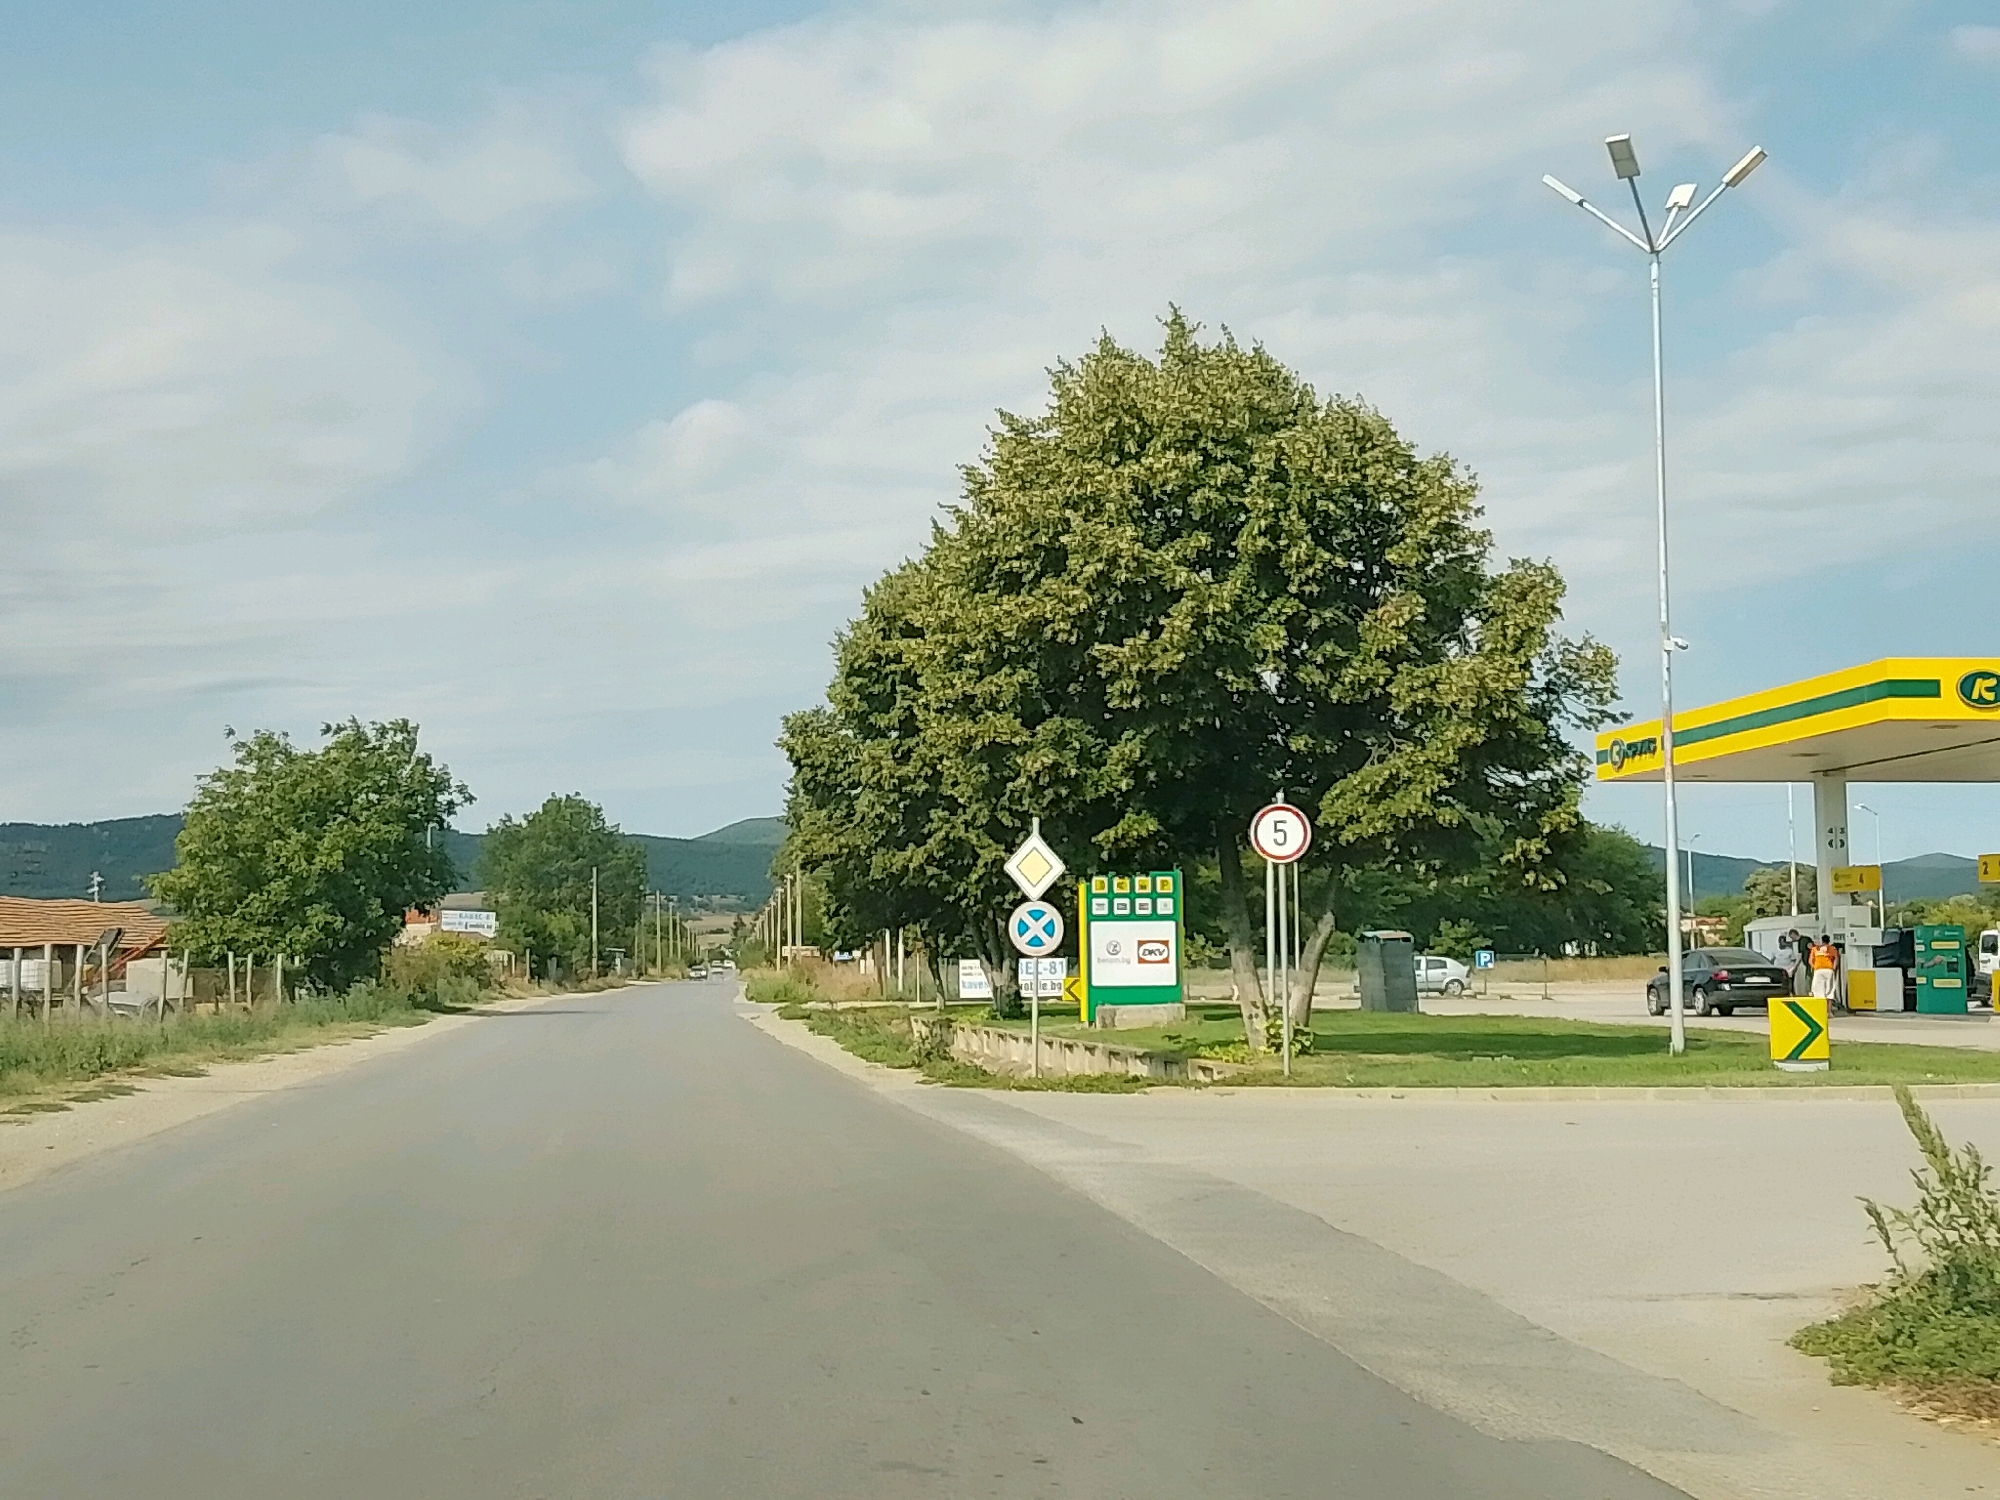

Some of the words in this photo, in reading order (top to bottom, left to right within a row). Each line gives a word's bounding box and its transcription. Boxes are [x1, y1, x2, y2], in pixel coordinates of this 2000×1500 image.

[1273, 820, 1287, 847] 5
[1142, 948, 1167, 957] DKV
[1480, 952, 1491, 966] P
